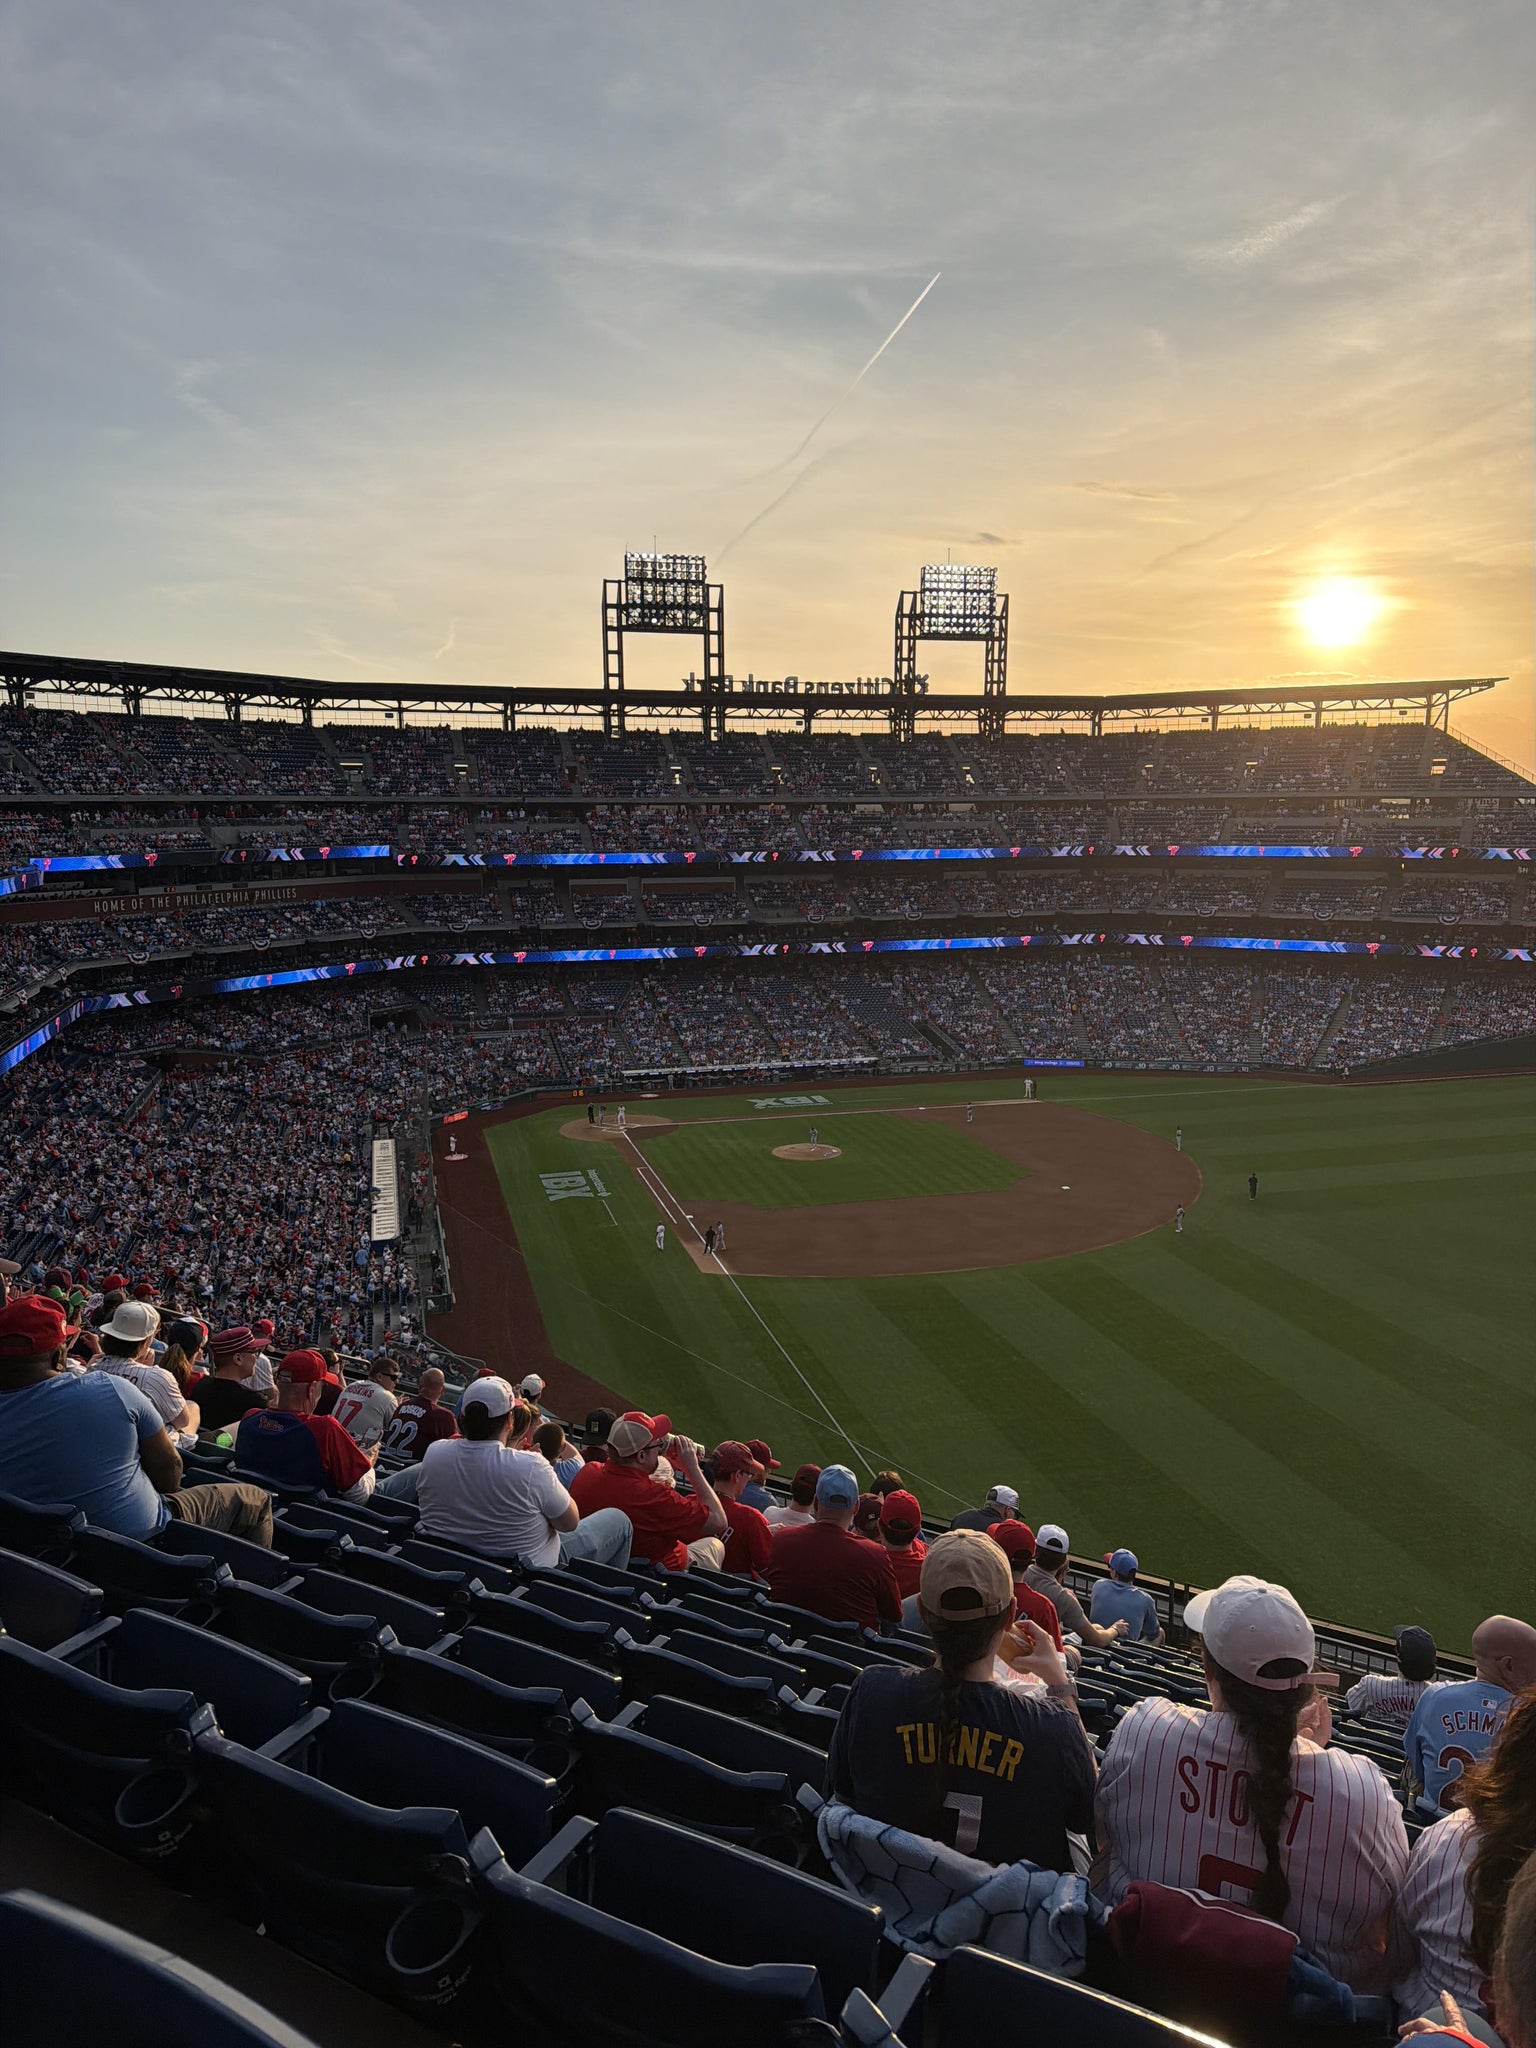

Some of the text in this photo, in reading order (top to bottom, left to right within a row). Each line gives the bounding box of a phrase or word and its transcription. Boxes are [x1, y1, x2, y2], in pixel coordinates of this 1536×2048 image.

[94, 900, 125, 913] HOME
[131, 898, 144, 910] OF
[150, 896, 170, 909] THE
[255, 887, 298, 901] PHILLIES
[538, 1170, 595, 1202] IBX
[335, 1398, 363, 1429] 17
[386, 1418, 419, 1458] 22
[1440, 1709, 1505, 1736] SCHM
[1178, 1755, 1315, 1847] STOT
